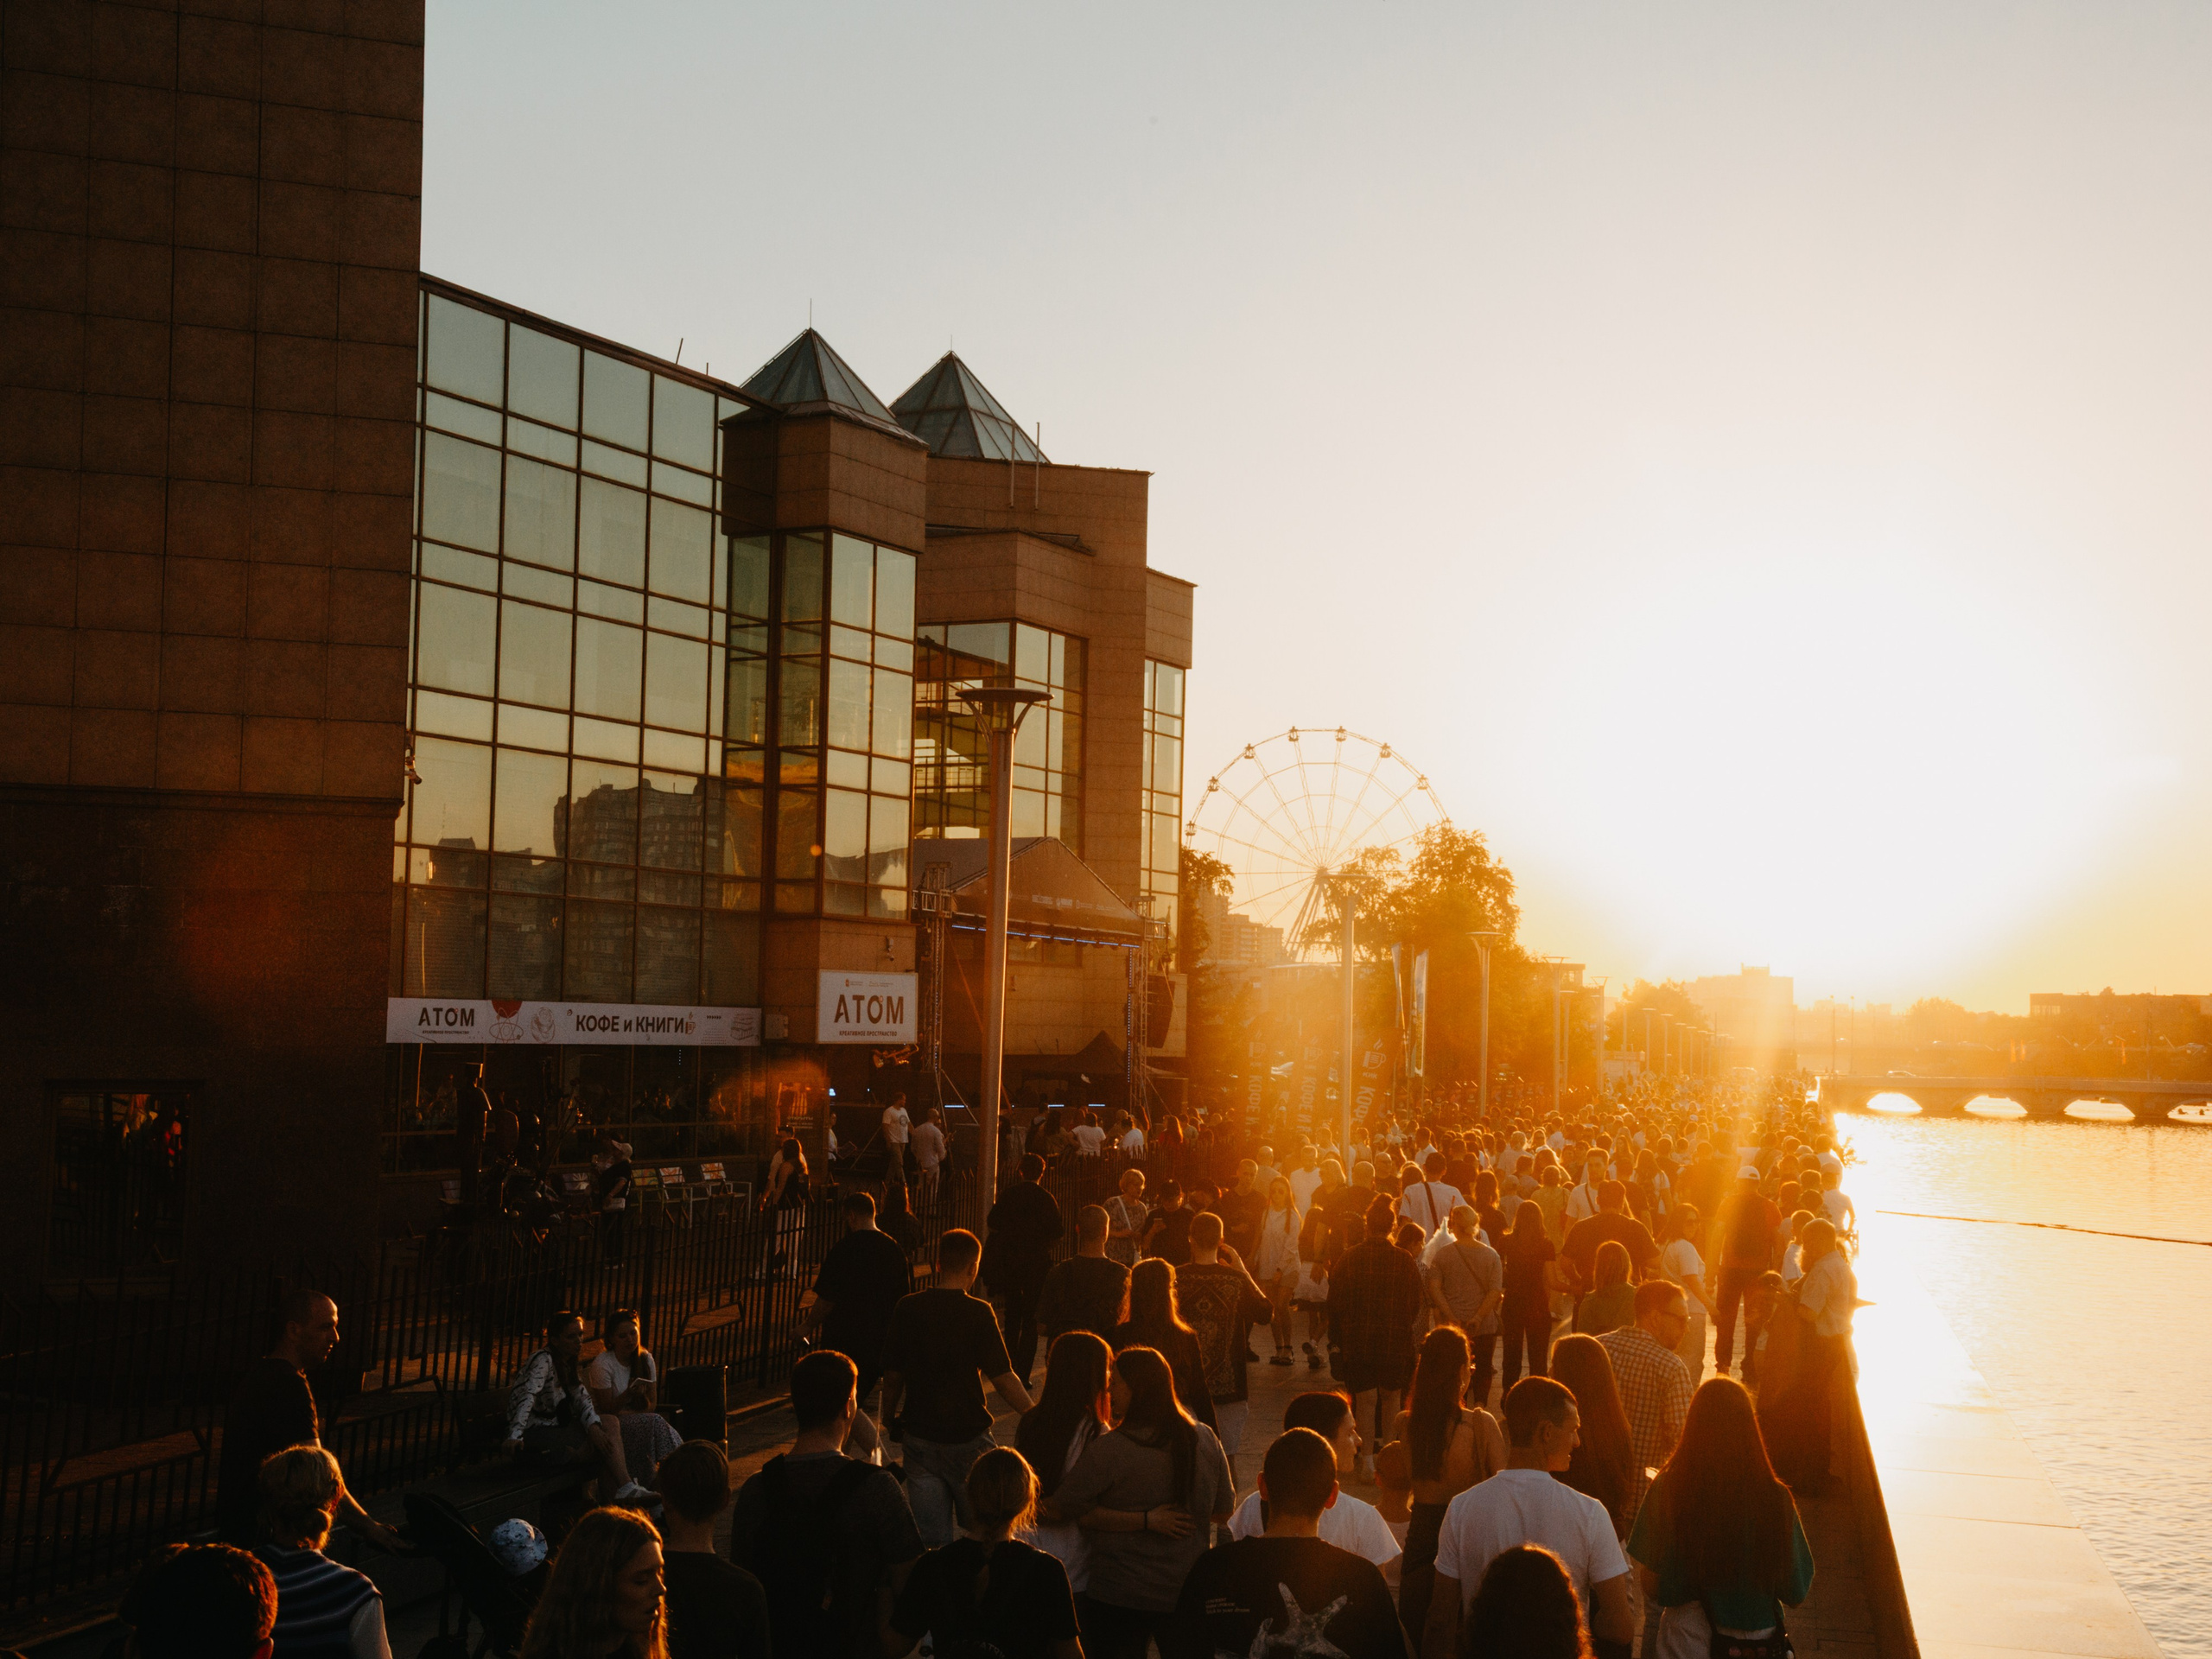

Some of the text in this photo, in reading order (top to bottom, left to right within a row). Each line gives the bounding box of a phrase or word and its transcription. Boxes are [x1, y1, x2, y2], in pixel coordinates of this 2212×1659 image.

[418, 1007, 474, 1027] АТОМ
[575, 1014, 620, 1033] КОФЕ
[636, 1016, 684, 1033] КНИГИ
[834, 994, 904, 1024] АТОМ
[1246, 1075, 1262, 1113] КОФЕ
[1299, 1077, 1317, 1112] КОФЕ
[1351, 1085, 1376, 1124] КОФЕ
